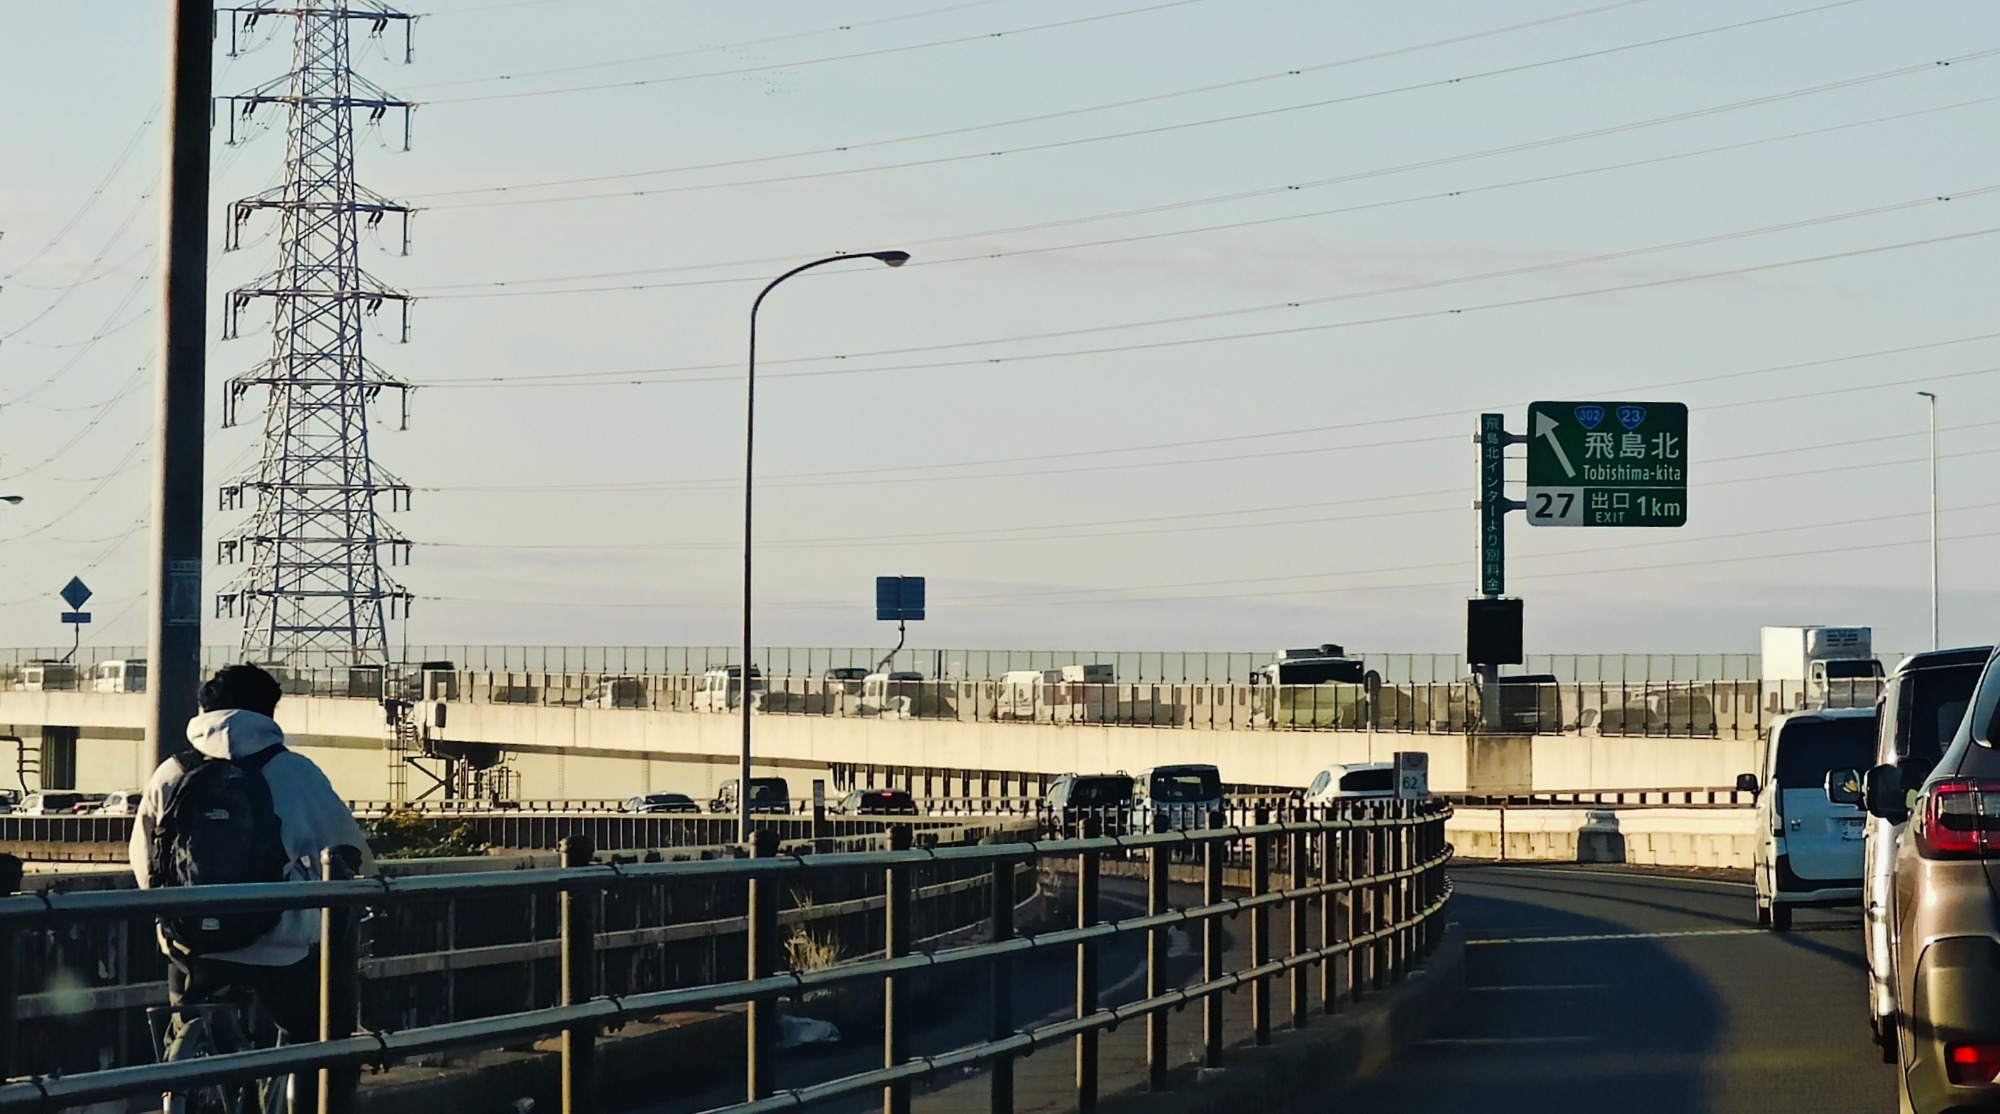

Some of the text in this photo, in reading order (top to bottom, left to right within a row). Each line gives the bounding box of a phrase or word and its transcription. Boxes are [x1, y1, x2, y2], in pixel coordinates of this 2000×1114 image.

[1579, 410, 1600, 421] 302
[1622, 410, 1640, 422] 23
[1585, 432, 1679, 459] 飛島北
[1583, 464, 1681, 481] Tobishima-kita
[1486, 417, 1499, 591] 飛島北インターより別料金
[1535, 493, 1575, 518] 27
[1592, 492, 1630, 509] 出口
[1596, 512, 1625, 523] EXIT
